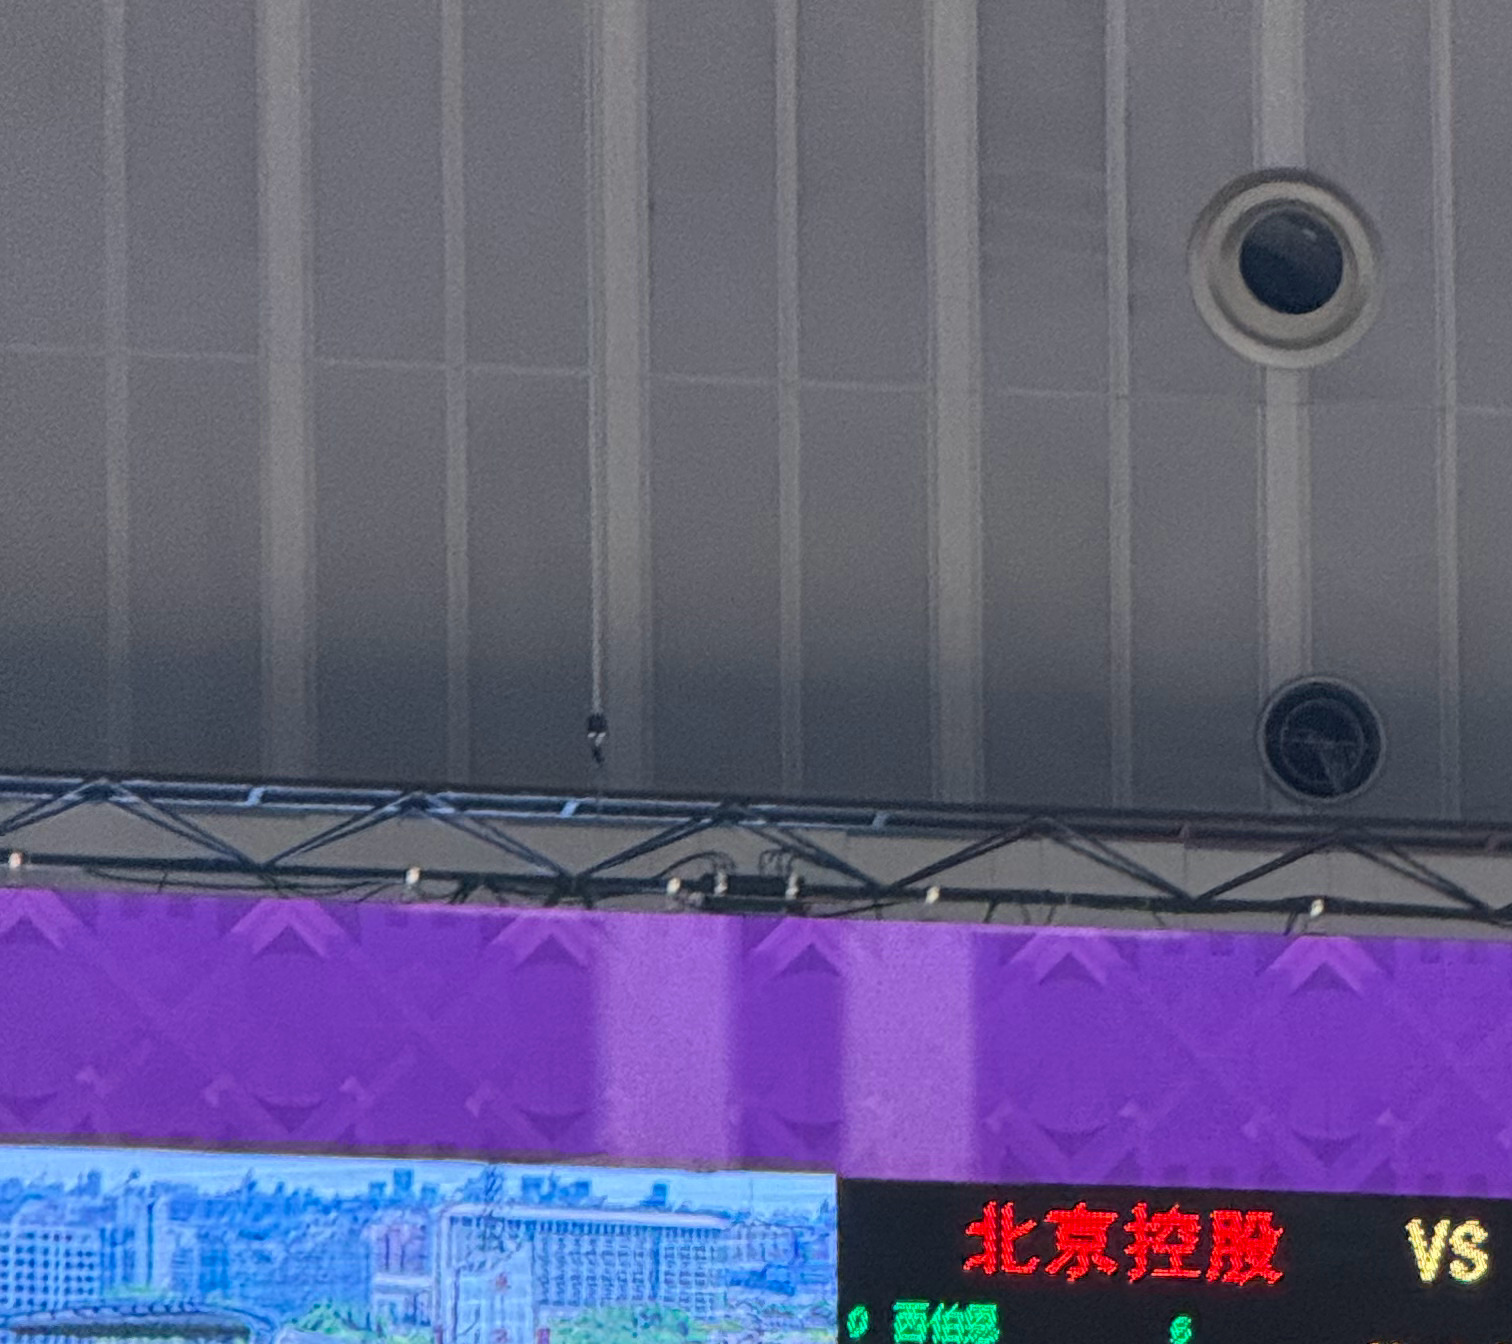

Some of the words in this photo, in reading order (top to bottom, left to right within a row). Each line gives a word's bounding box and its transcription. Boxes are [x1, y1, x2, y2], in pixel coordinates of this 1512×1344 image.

[962, 1201, 1284, 1287] 北京控股
[1405, 1218, 1489, 1283] VS
[846, 1305, 869, 1339] 0
